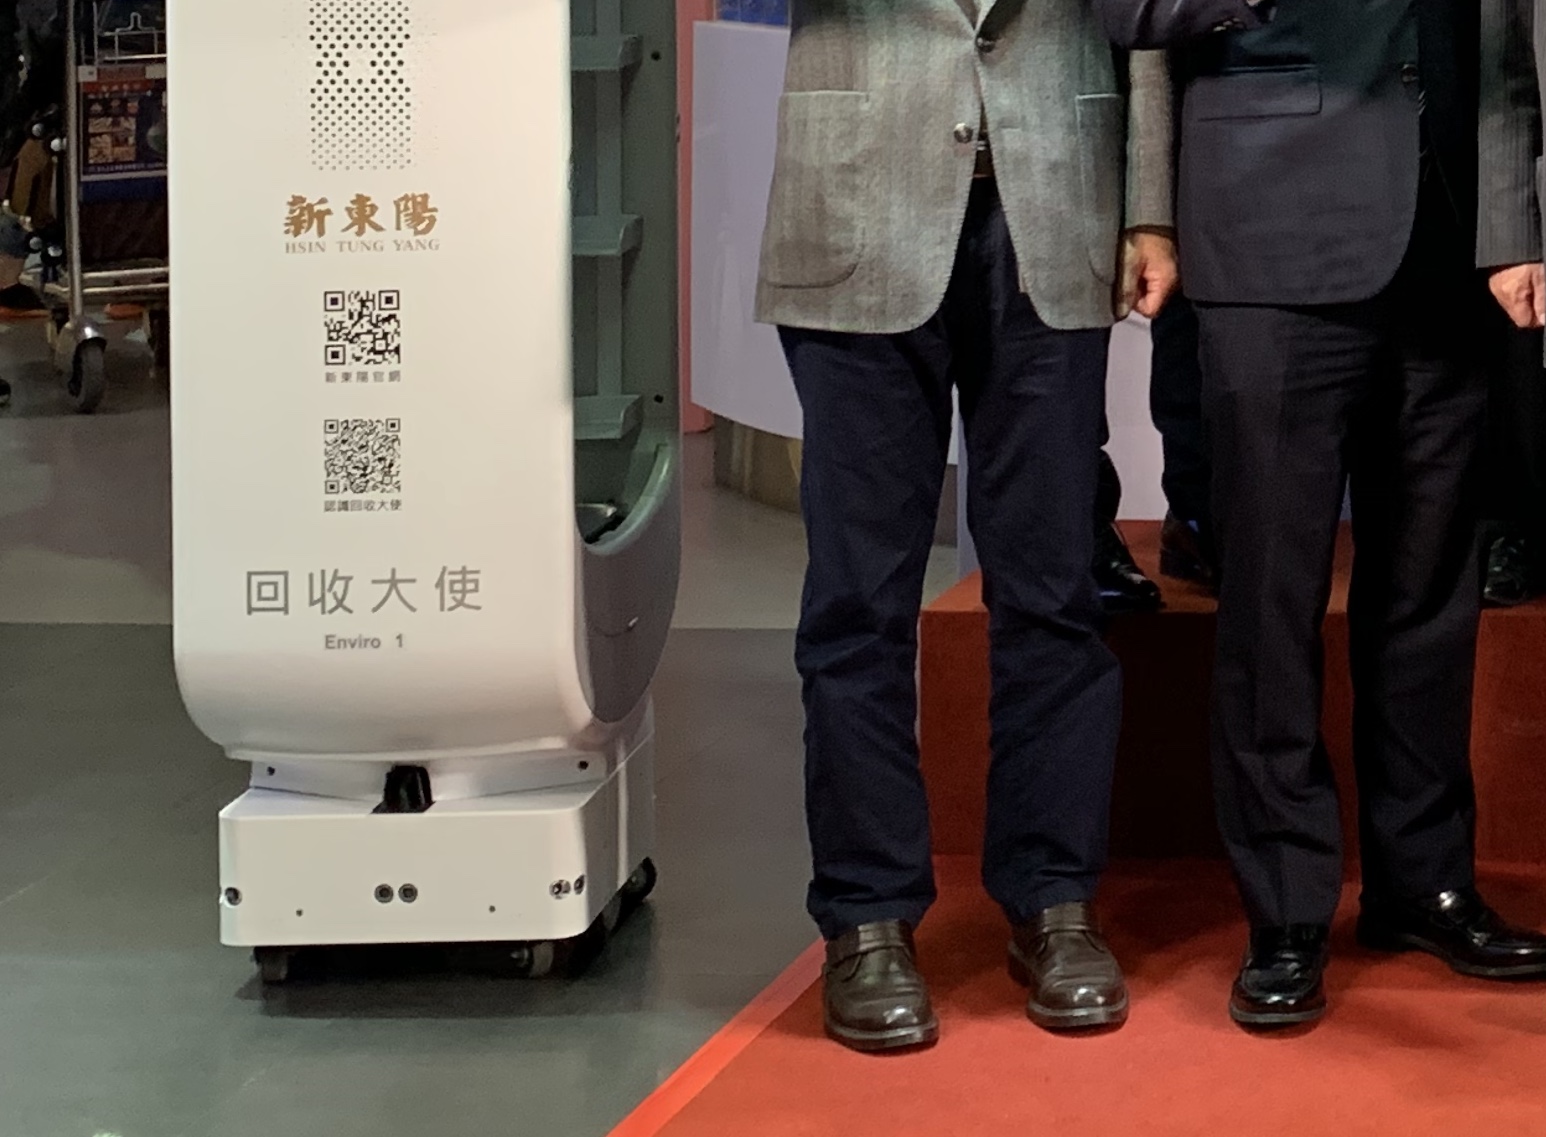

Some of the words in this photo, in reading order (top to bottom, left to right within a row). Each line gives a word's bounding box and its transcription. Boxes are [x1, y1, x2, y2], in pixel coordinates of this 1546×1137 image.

[284, 193, 438, 238] 新東陽
[285, 241, 326, 254] HSIN
[336, 240, 384, 252] TUNG
[393, 238, 440, 251] YANG
[247, 566, 482, 615] 回收大使
[325, 635, 381, 650] Enviro
[395, 633, 404, 648] 1
